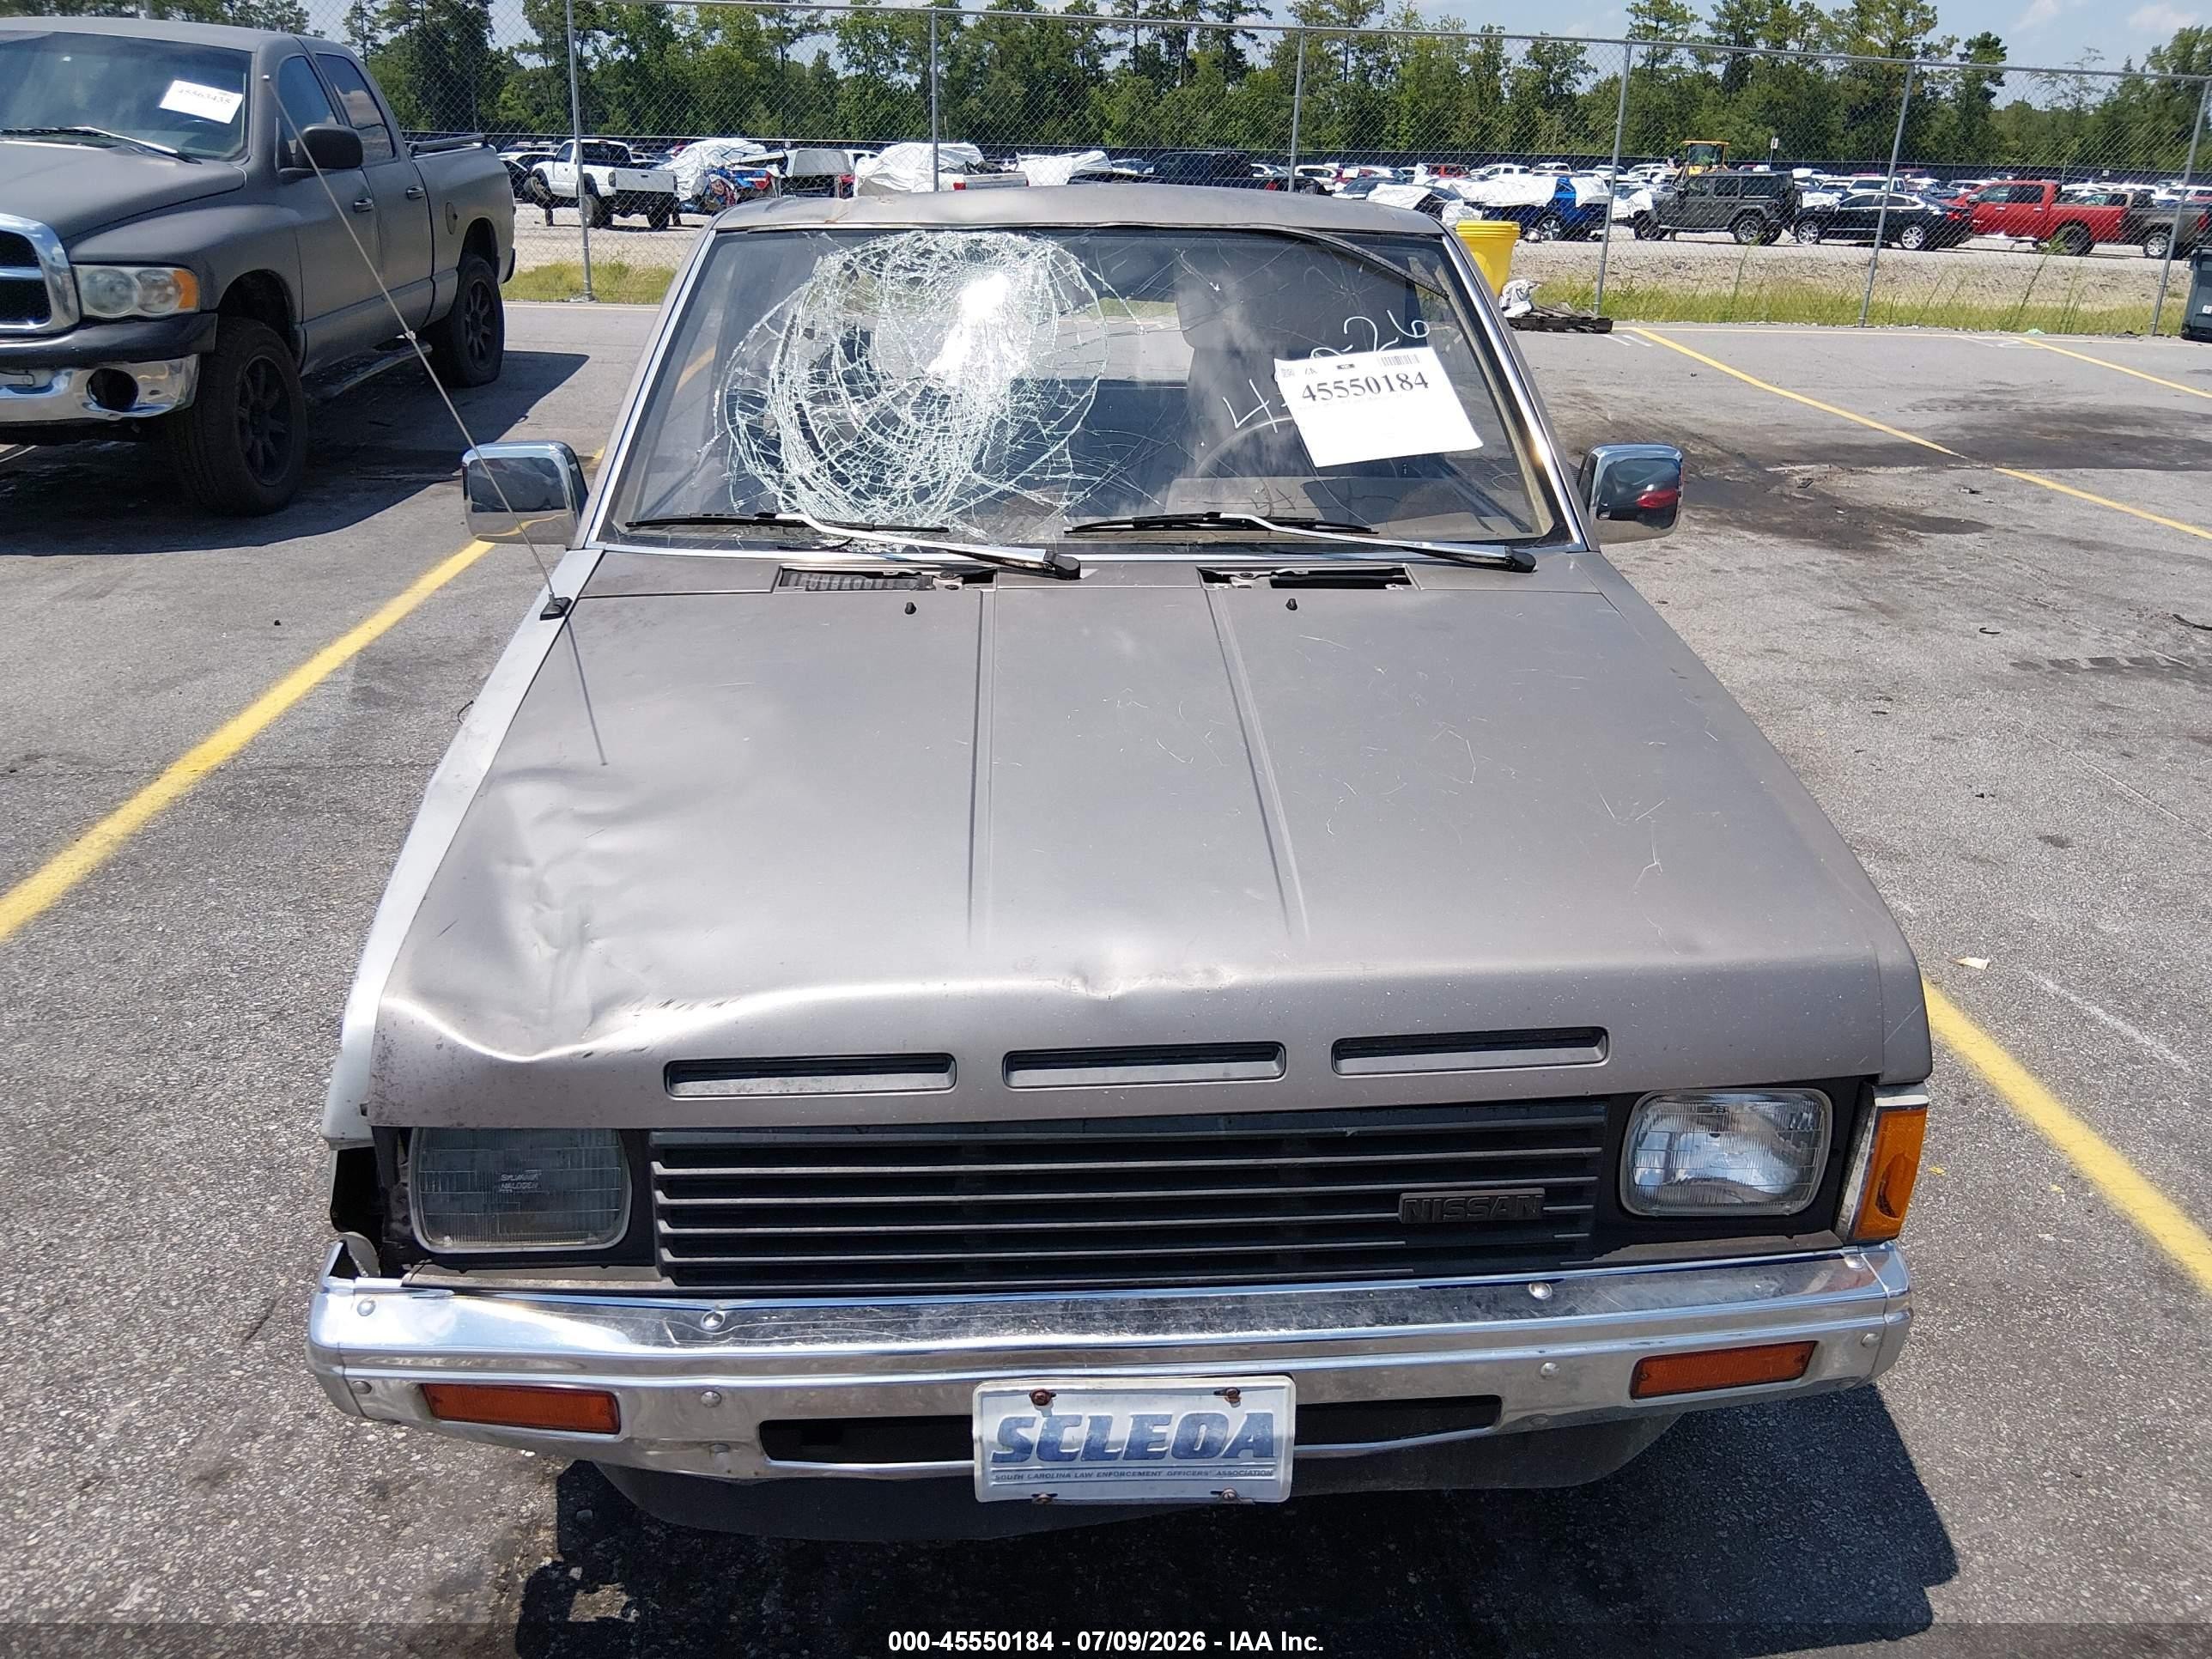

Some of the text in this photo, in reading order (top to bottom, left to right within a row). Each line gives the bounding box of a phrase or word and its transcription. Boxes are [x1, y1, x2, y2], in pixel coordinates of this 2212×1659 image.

[1302, 371, 1429, 402] 45550184
[1404, 1194, 1543, 1223] NISSAN
[990, 1413, 1276, 1462] SCLEOA
[1096, 1469, 1162, 1478] ENFORCEMENT
[1216, 1468, 1274, 1477] ASSOCIATION
